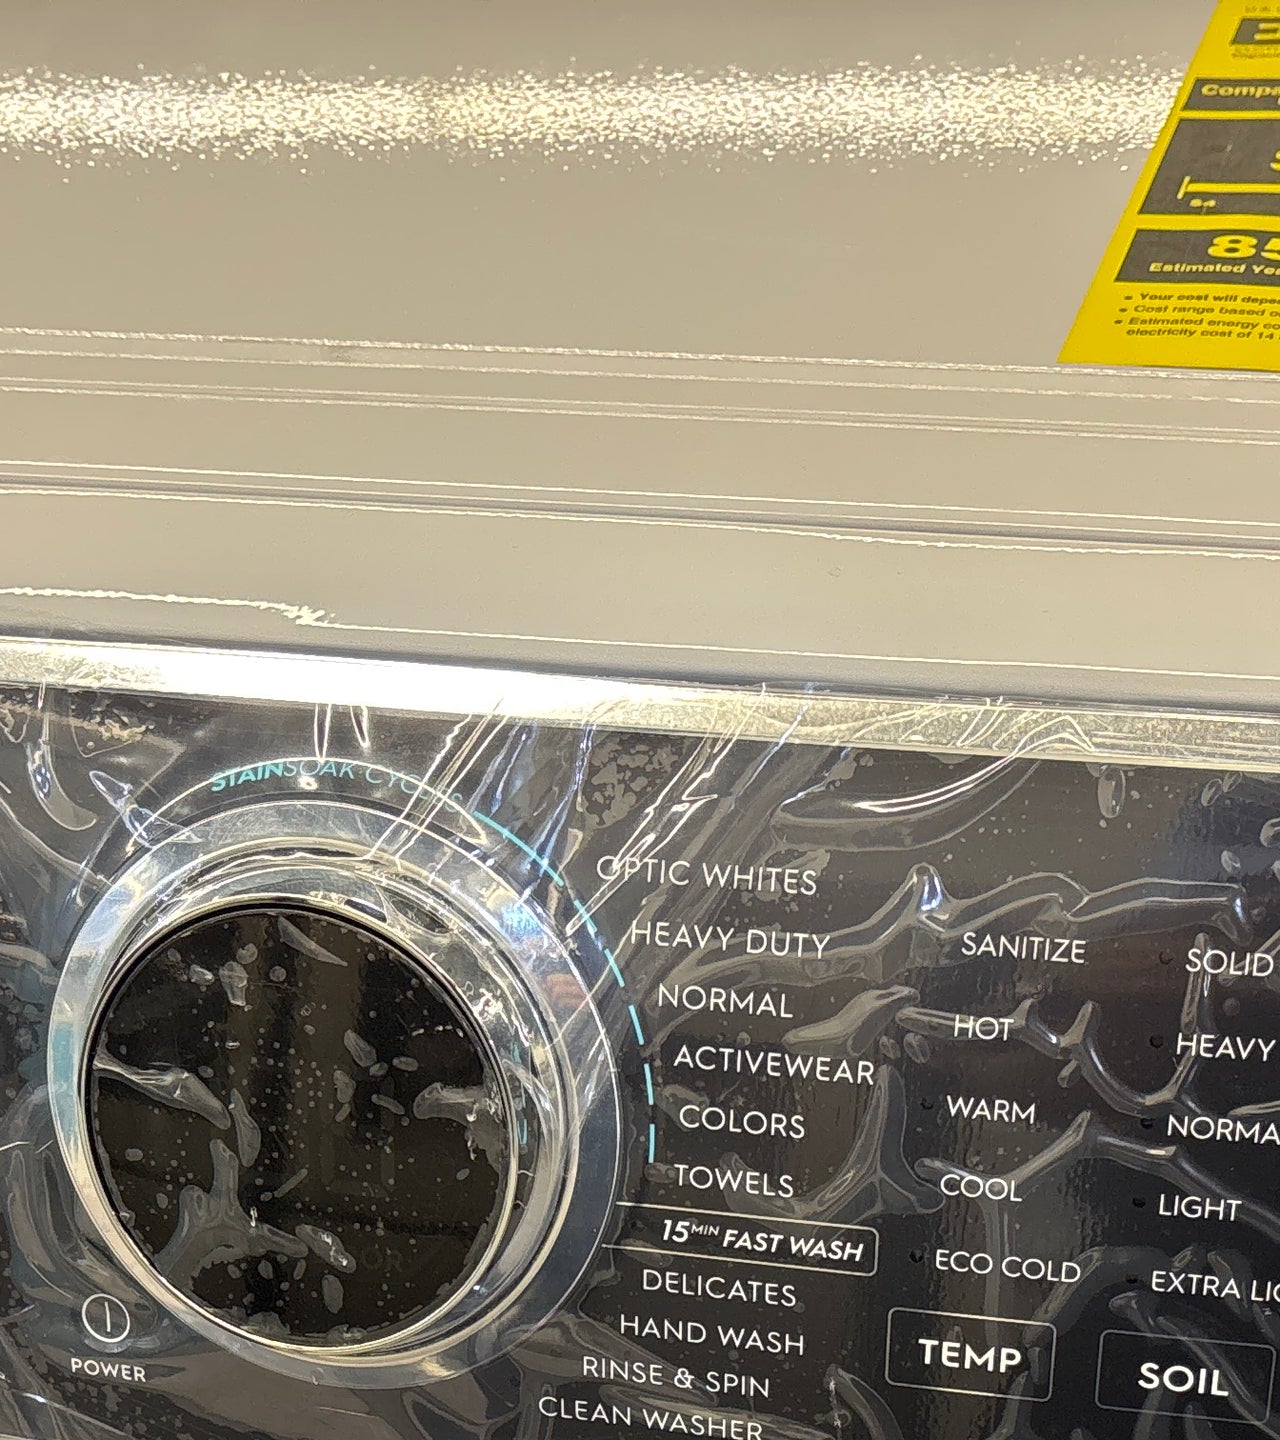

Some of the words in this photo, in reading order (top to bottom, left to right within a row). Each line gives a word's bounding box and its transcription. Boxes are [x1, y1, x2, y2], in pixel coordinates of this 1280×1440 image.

[1148, 262, 1246, 275] Estimated
[1133, 304, 1169, 314] Cost
[1171, 305, 1216, 317] range
[1219, 307, 1266, 317] based
[1140, 292, 1175, 302] Your
[1176, 293, 1209, 302] cost
[1212, 293, 1238, 303] will
[596, 854, 691, 887] OPTIC
[702, 861, 818, 896] WHITES
[630, 920, 734, 951] HEAVY
[745, 928, 832, 960] DUTY
[960, 931, 1088, 965] SANITIZE
[1185, 948, 1275, 979] SOLID
[657, 982, 794, 1019] NORMAL
[953, 1014, 1015, 1043] HOT
[1175, 1032, 1277, 1064] HEAVY
[672, 1045, 875, 1087] ACTIVEWEAR
[678, 1104, 806, 1140] COLORS
[945, 1094, 1037, 1125] WARM
[673, 1163, 795, 1199] TOWELS
[939, 1172, 1024, 1202] COOL
[1157, 1193, 1243, 1223] LIGHT
[722, 1228, 783, 1254] FAST
[788, 1235, 865, 1263] WASH
[934, 1248, 994, 1277] ECO
[1001, 1255, 1082, 1285] COLD
[641, 1268, 797, 1308] DELICATES
[1150, 1270, 1241, 1301] EXTRA
[619, 1313, 708, 1344] HAND
[716, 1324, 806, 1357] WASH
[69, 1356, 147, 1384] POWER
[917, 1338, 1023, 1375] TEMP
[581, 1355, 664, 1387] RINSE
[673, 1366, 695, 1389] &
[704, 1370, 771, 1399] SPIN
[1136, 1361, 1231, 1398] SOIL
[537, 1395, 632, 1427] CLEAN
